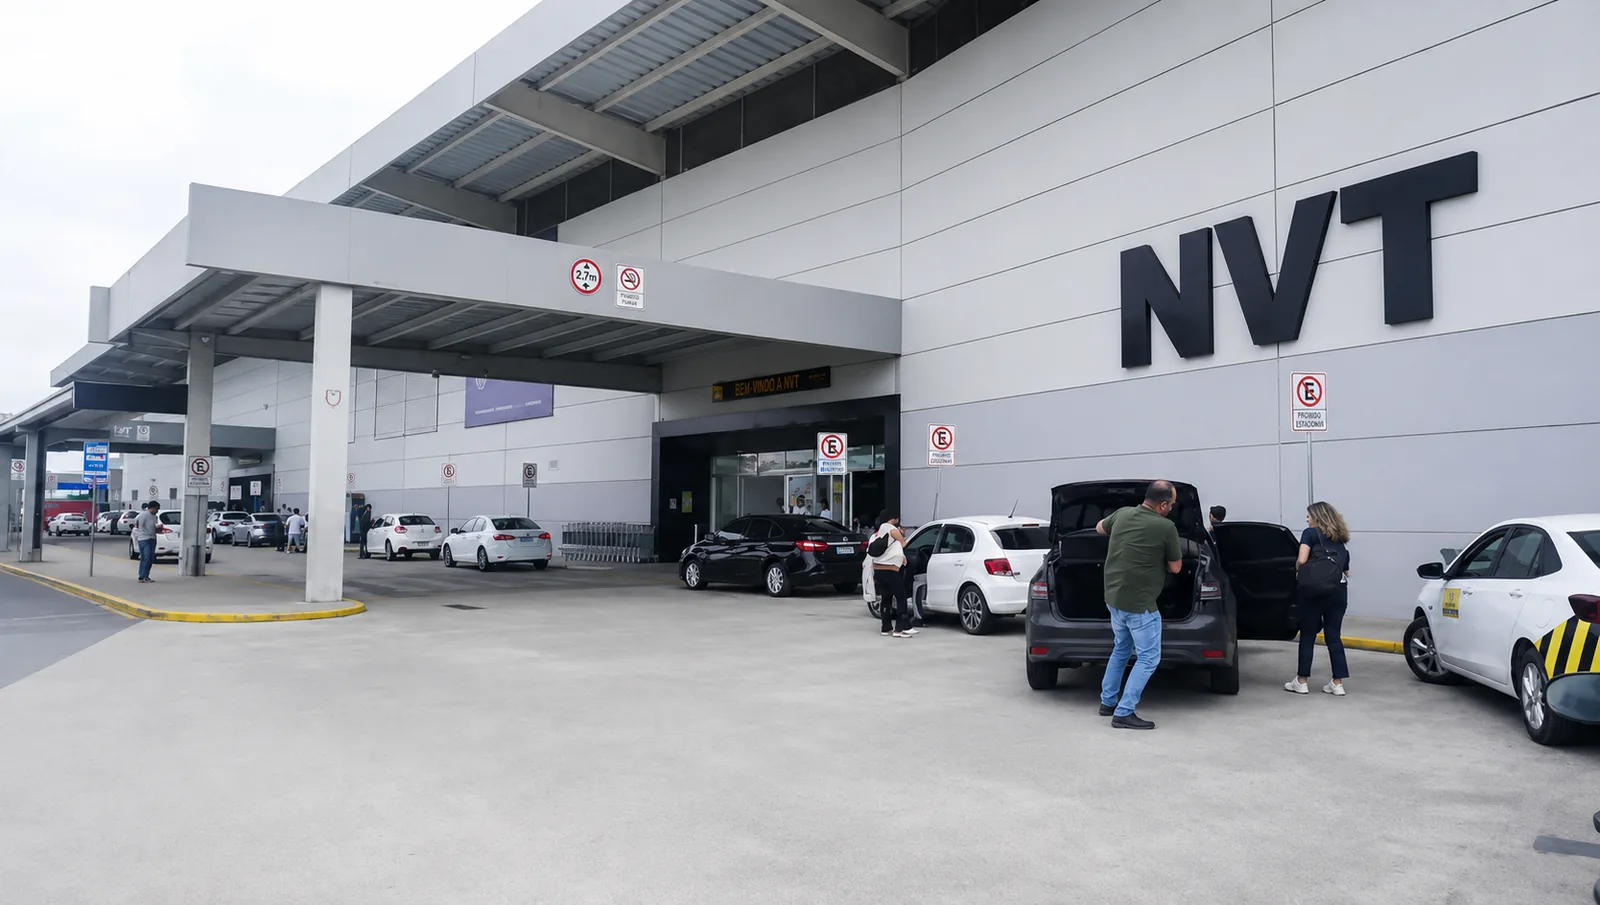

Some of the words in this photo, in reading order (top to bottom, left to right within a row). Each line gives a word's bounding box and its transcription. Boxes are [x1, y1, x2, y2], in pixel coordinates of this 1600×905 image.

[1120, 151, 1478, 368] NVT
[576, 270, 597, 282] 2.7m
[735, 378, 775, 397] BEM-VINDO
[777, 379, 783, 392] A
[784, 374, 799, 389] NVT
[1305, 382, 1314, 400] E
[938, 431, 947, 445] E
[828, 439, 837, 454] E
